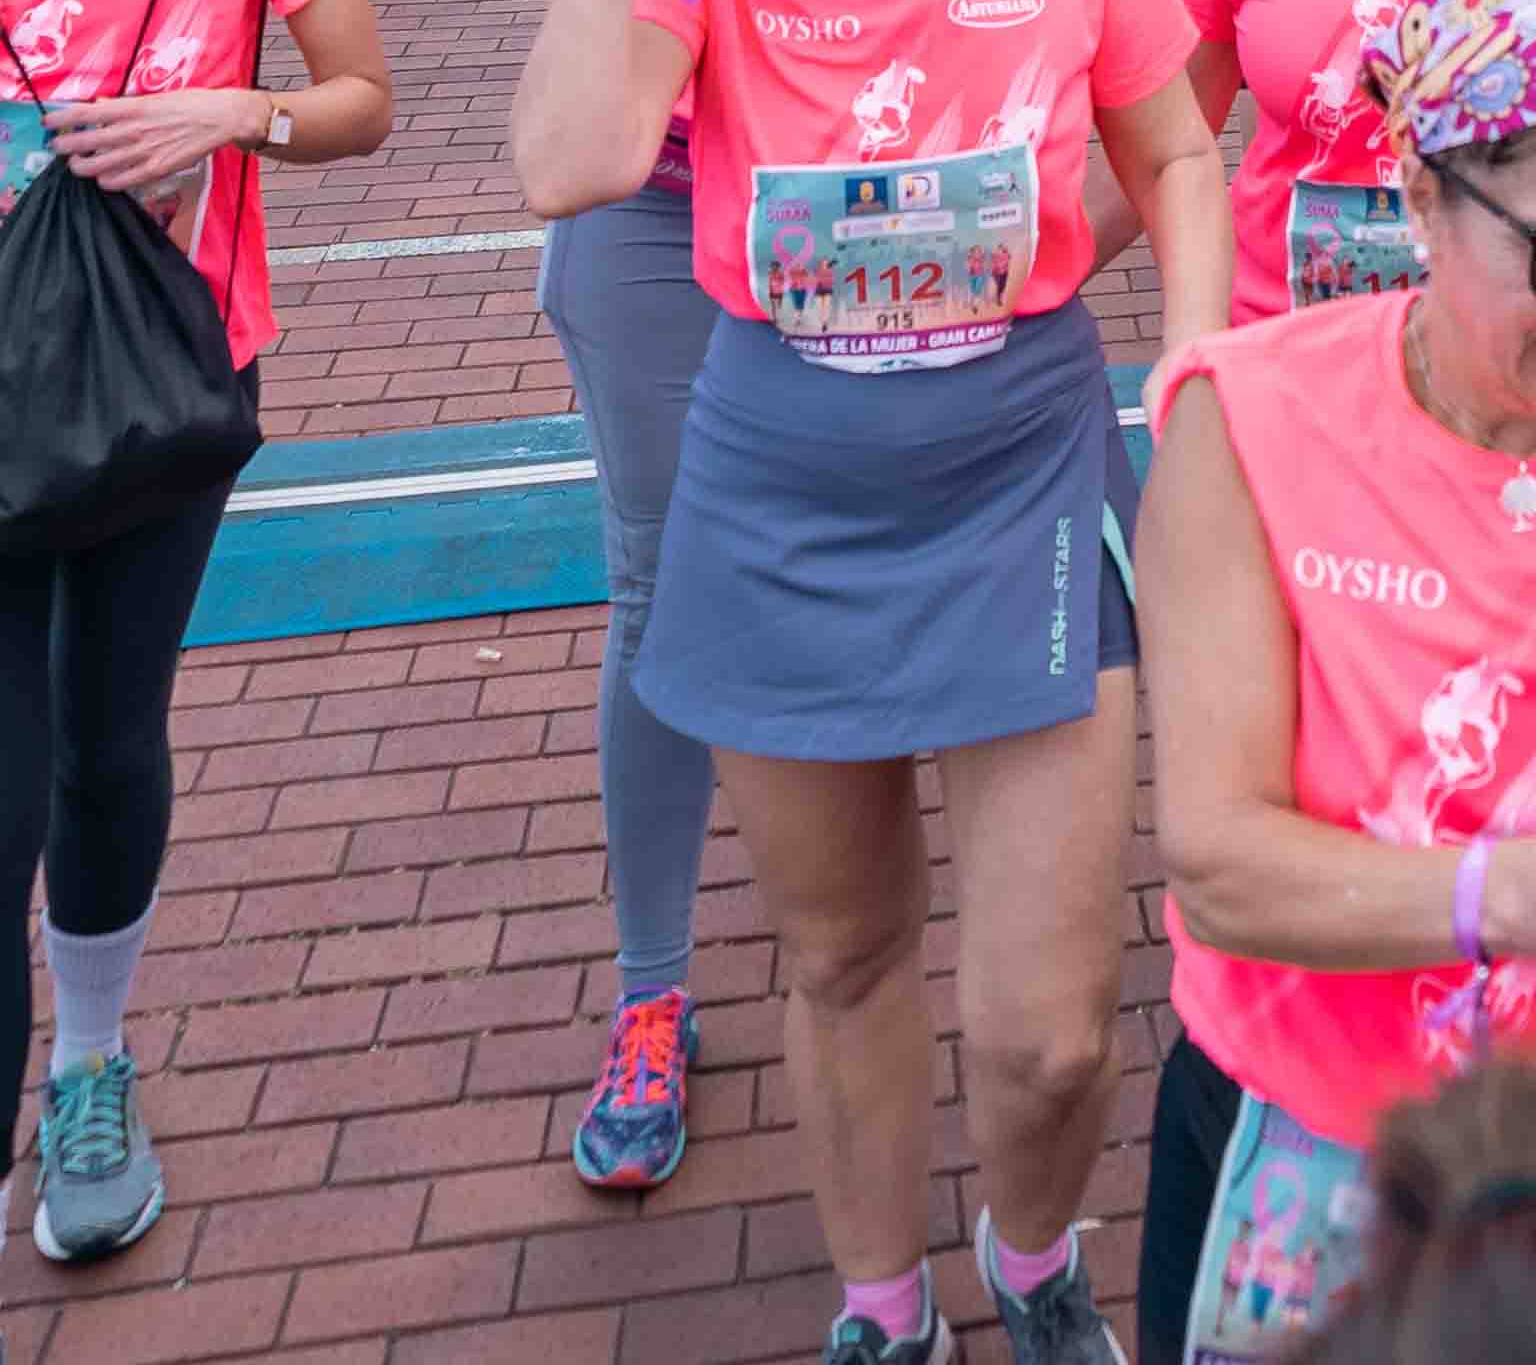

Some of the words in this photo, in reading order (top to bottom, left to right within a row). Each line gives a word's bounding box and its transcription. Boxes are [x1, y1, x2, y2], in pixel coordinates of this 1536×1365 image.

[755, 8, 862, 41] OYSHO
[844, 261, 945, 306] 112
[876, 313, 914, 332] 915
[1293, 546, 1449, 612] OYSHO
